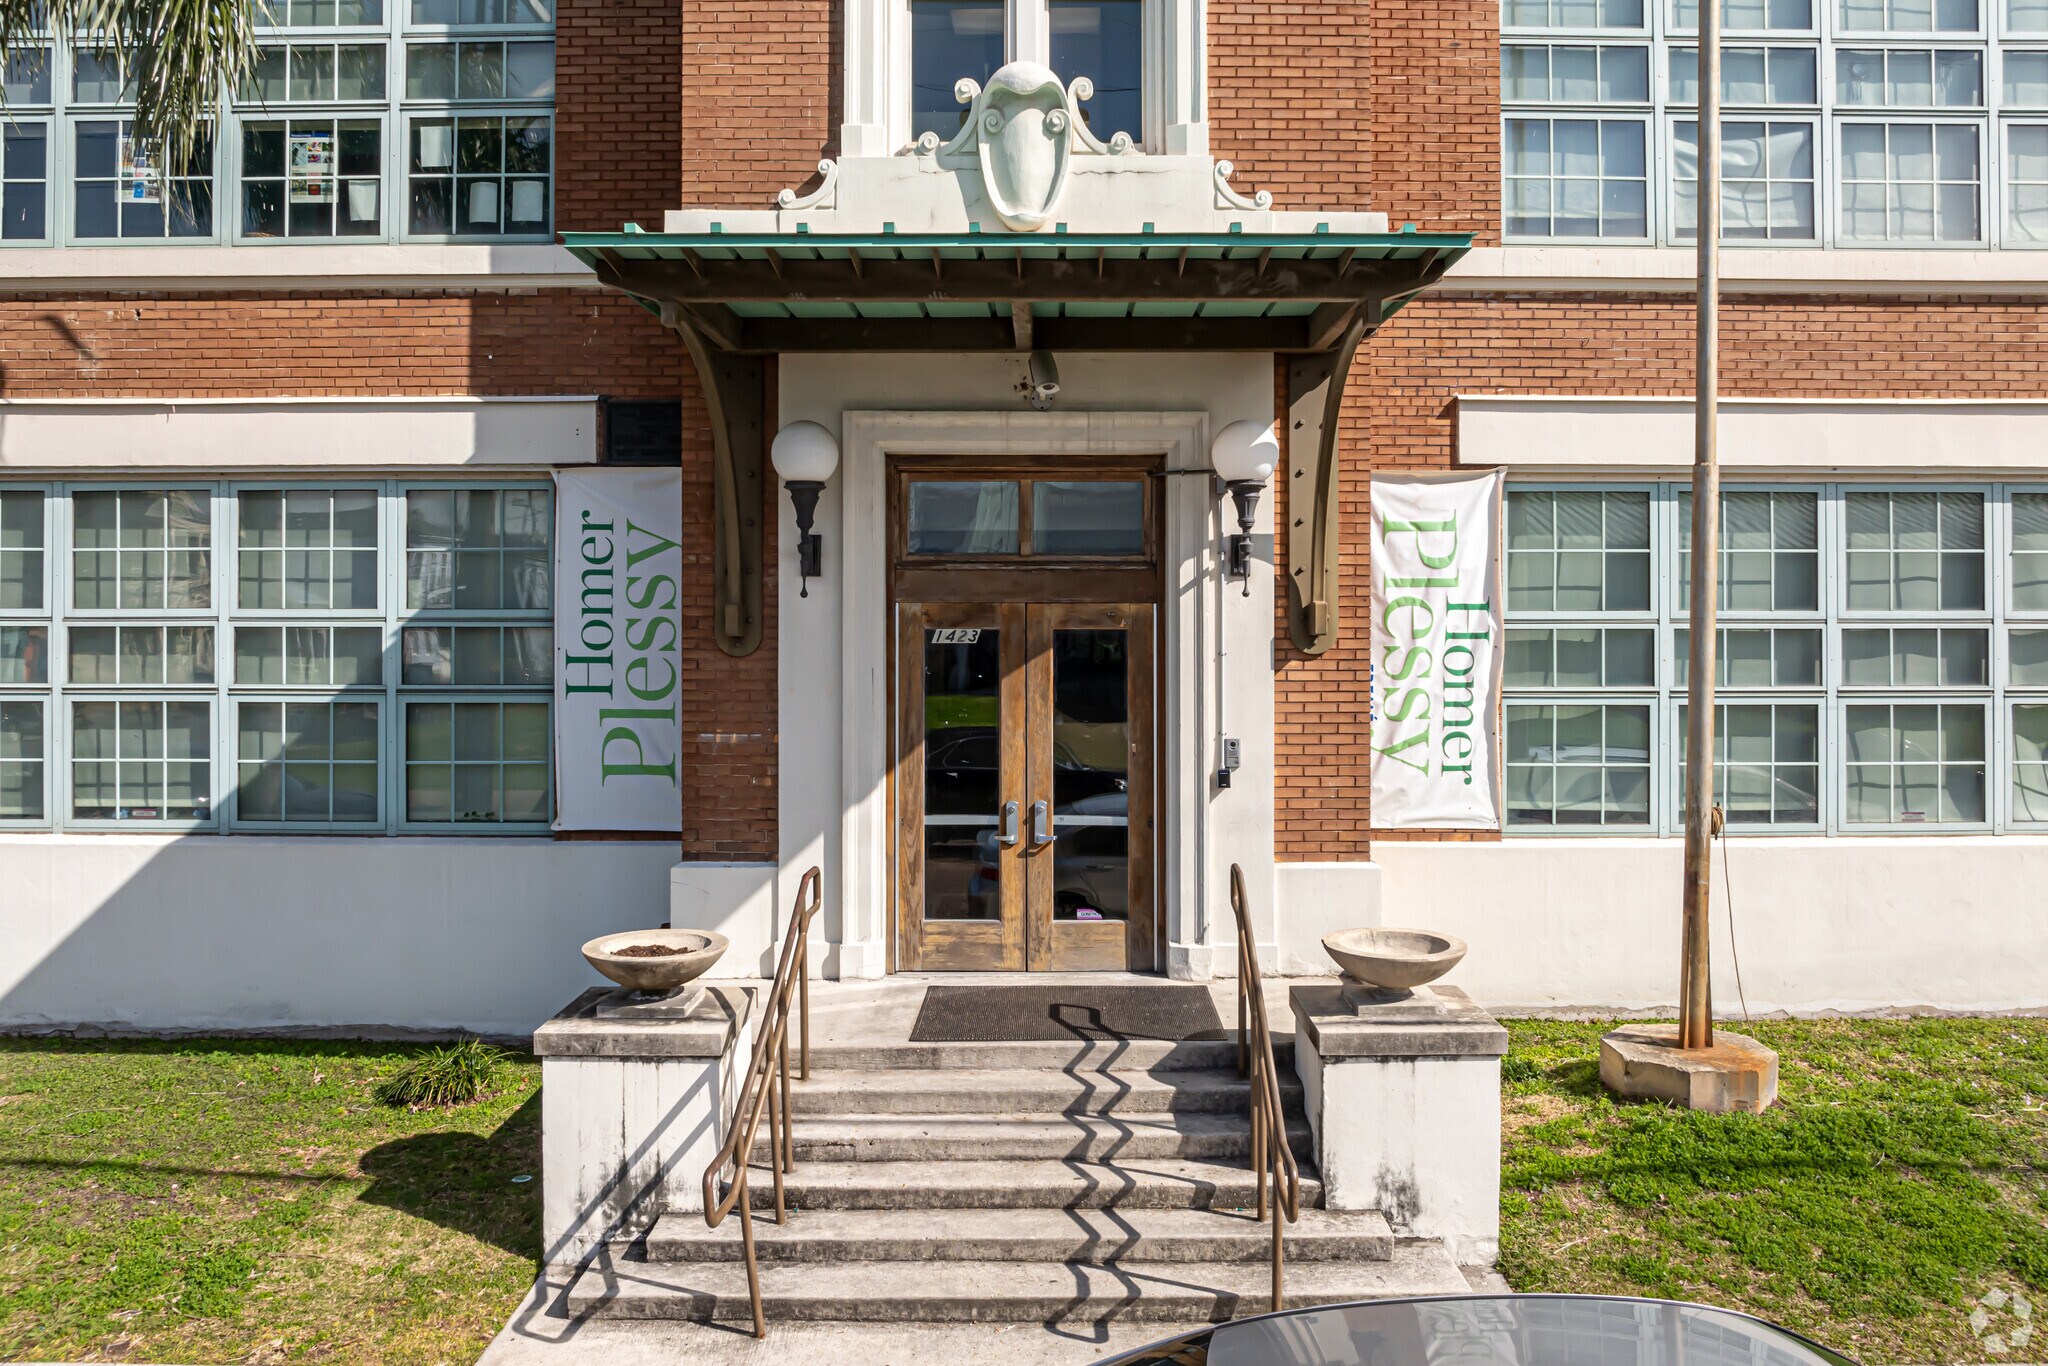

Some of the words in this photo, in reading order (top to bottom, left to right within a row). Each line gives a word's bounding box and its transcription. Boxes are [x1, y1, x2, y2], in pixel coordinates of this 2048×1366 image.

[565, 509, 614, 701] Homer
[599, 517, 682, 788] Plessy
[935, 629, 979, 643] 1423
[1370, 508, 1459, 778] Plessy
[1441, 594, 1490, 786] Homer
